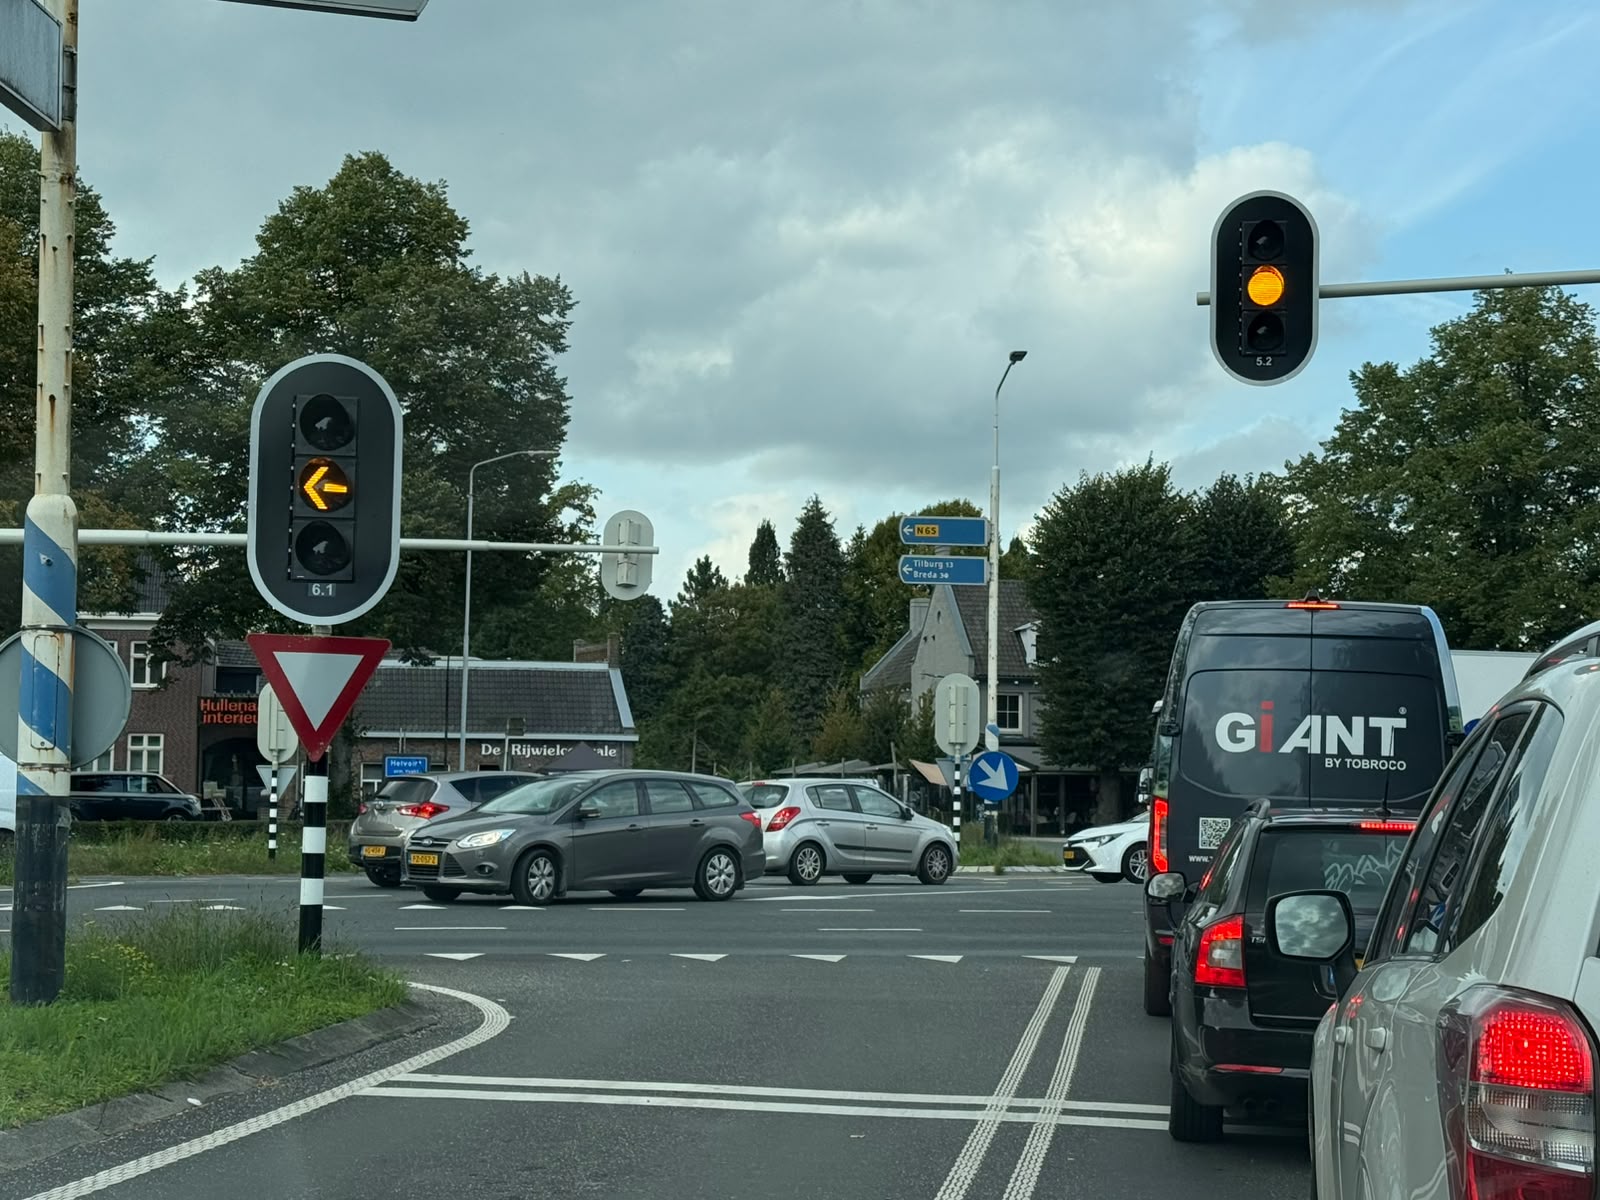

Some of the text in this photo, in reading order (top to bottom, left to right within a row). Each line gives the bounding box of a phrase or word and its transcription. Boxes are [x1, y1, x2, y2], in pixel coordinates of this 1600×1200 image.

[1255, 356, 1273, 366] 5.2
[913, 559, 943, 570] Tilburg
[913, 570, 938, 579] Breda
[311, 583, 333, 596] 6.1
[200, 698, 257, 712] Hullena
[480, 743, 617, 758] De Rijwielcale
[1324, 758, 1407, 771] BY TOBROCO
